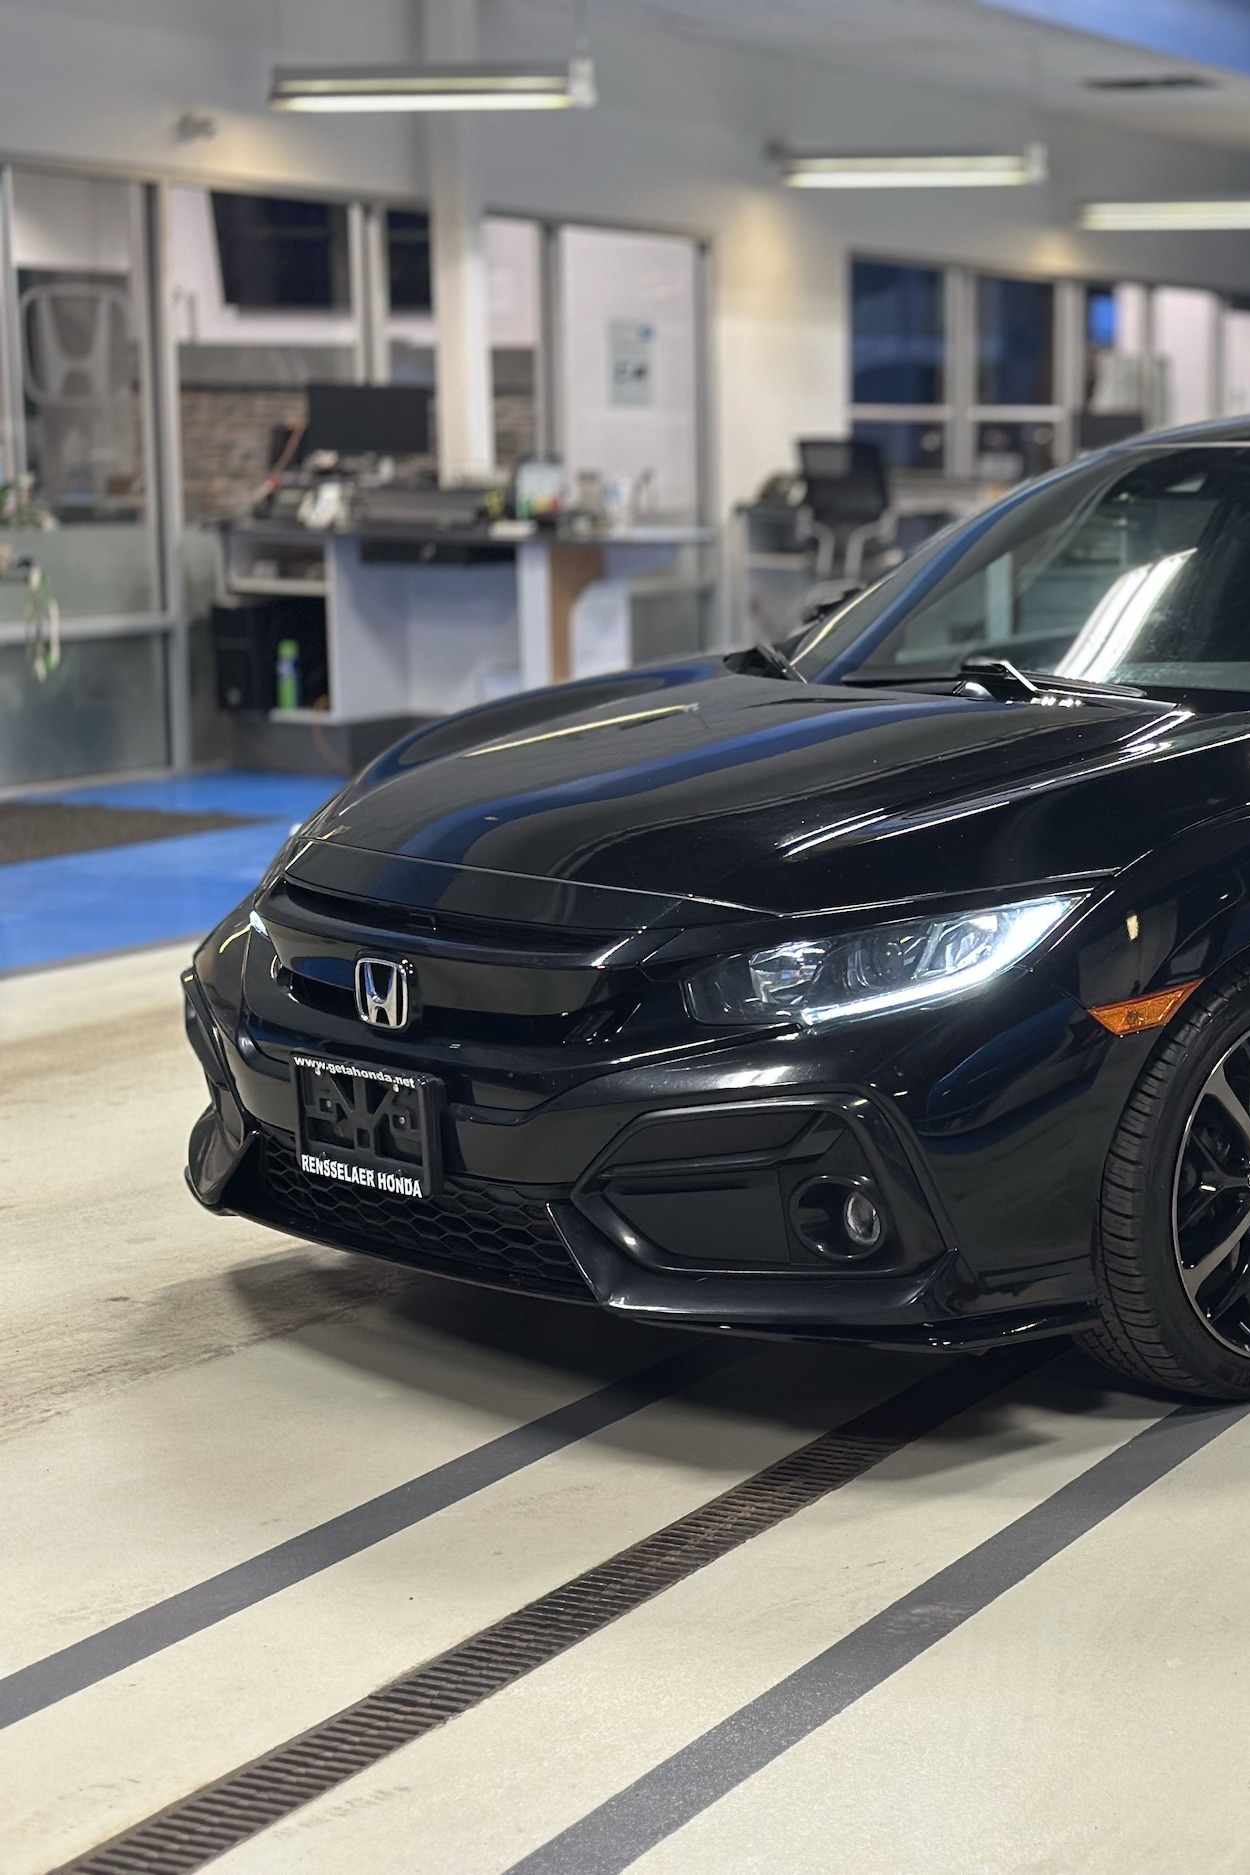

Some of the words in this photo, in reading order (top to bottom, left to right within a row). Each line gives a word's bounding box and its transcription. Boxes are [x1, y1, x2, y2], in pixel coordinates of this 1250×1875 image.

[294, 1056, 415, 1088] www.getahonda.net
[301, 1154, 375, 1187] RENSSELAER
[377, 1172, 422, 1198] HONDA
